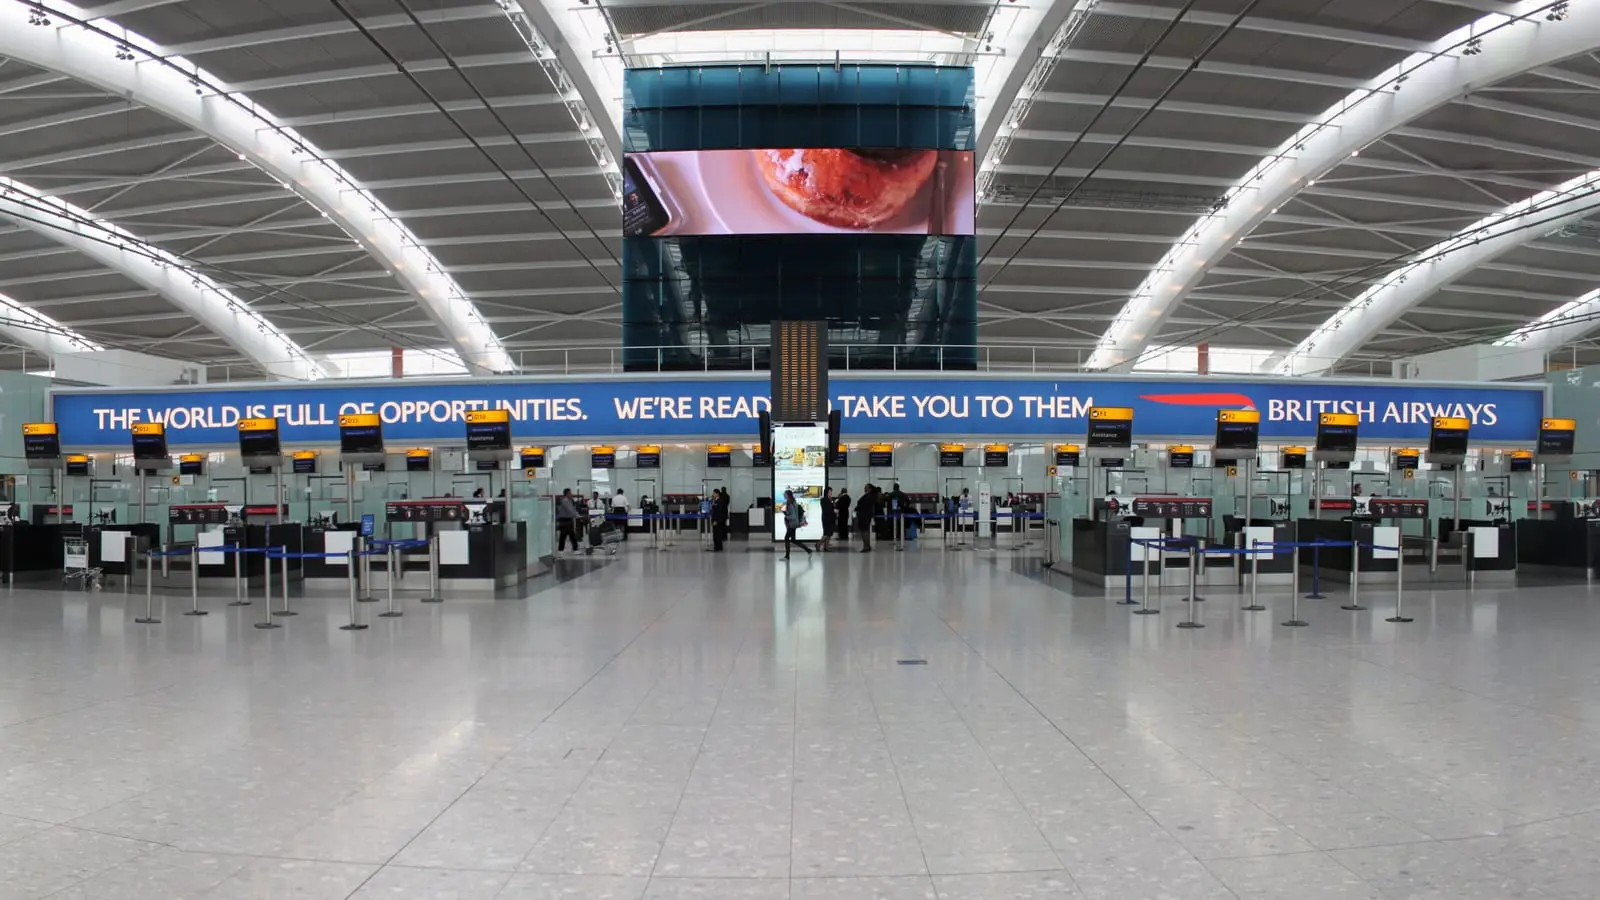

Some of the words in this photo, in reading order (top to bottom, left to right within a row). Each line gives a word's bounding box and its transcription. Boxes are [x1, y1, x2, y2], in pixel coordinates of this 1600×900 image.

[93, 408, 141, 429] THE
[147, 406, 240, 429] WORLD
[246, 404, 267, 419] IS
[273, 403, 334, 426] FULL
[613, 396, 693, 419] WE'RE
[699, 396, 771, 419] READ
[837, 396, 906, 418] TAKE
[911, 396, 969, 418] YOU
[975, 396, 1014, 418] TO
[1019, 396, 1094, 419] THEM
[1268, 399, 1376, 424] BRITISH
[1382, 401, 1498, 426] AIRWAYS
